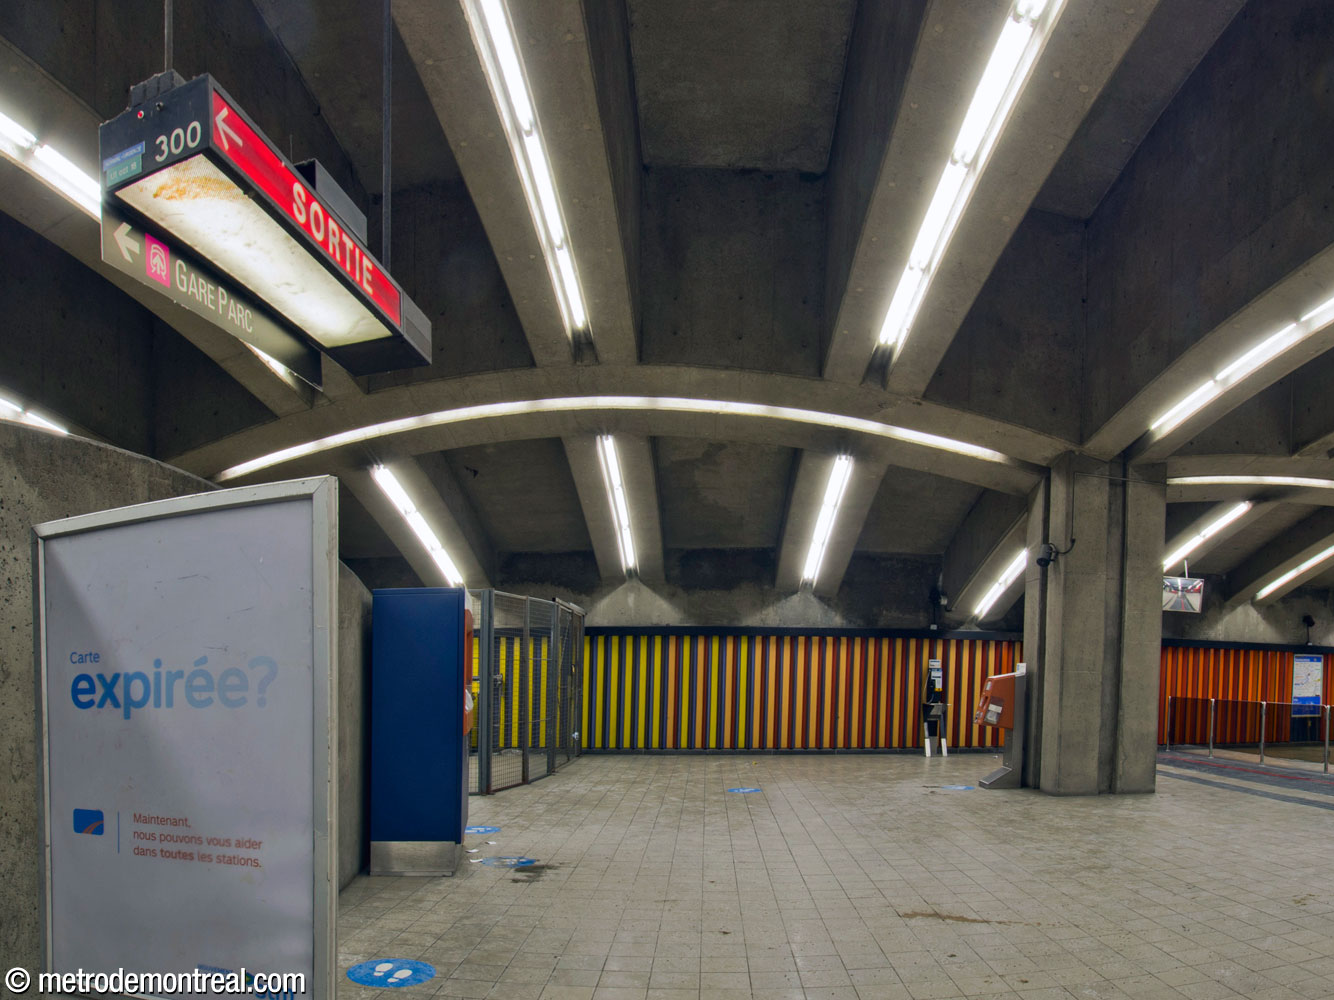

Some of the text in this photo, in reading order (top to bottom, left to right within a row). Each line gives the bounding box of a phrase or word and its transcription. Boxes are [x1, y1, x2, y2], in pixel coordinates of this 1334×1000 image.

[155, 121, 202, 162] 300
[293, 181, 374, 296] SORTIE
[175, 259, 253, 333] GARE PARC
[70, 651, 100, 664] Carte
[70, 655, 279, 721] expirée?
[133, 812, 192, 828] Maintenant,
[133, 830, 263, 850] nous pouvons vous aider
[133, 846, 263, 868] dans toutes les stations.
